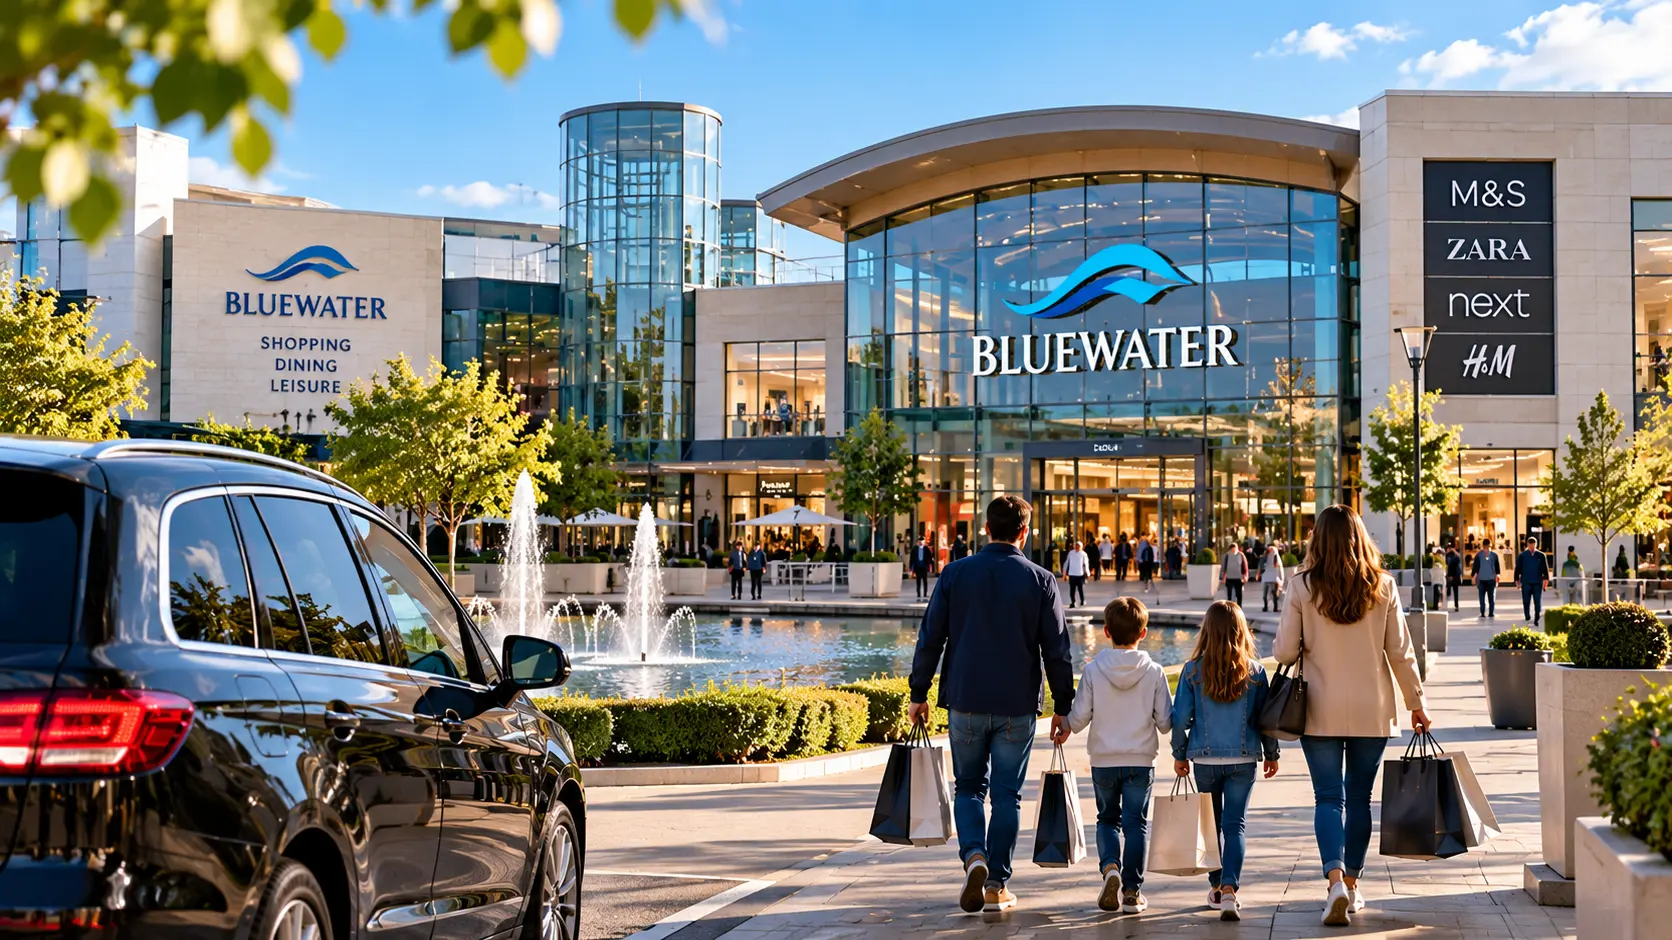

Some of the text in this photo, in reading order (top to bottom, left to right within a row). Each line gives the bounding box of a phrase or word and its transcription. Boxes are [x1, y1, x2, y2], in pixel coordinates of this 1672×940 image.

[1451, 179, 1526, 207] M&S
[1447, 238, 1531, 261] ZARA
[225, 291, 388, 320] BLUEWATER
[1449, 289, 1530, 318] next
[260, 335, 351, 353] SHOPPING
[972, 324, 1240, 377] BLUEWATER
[275, 357, 338, 373] DINING
[270, 379, 341, 394] LEISURE
